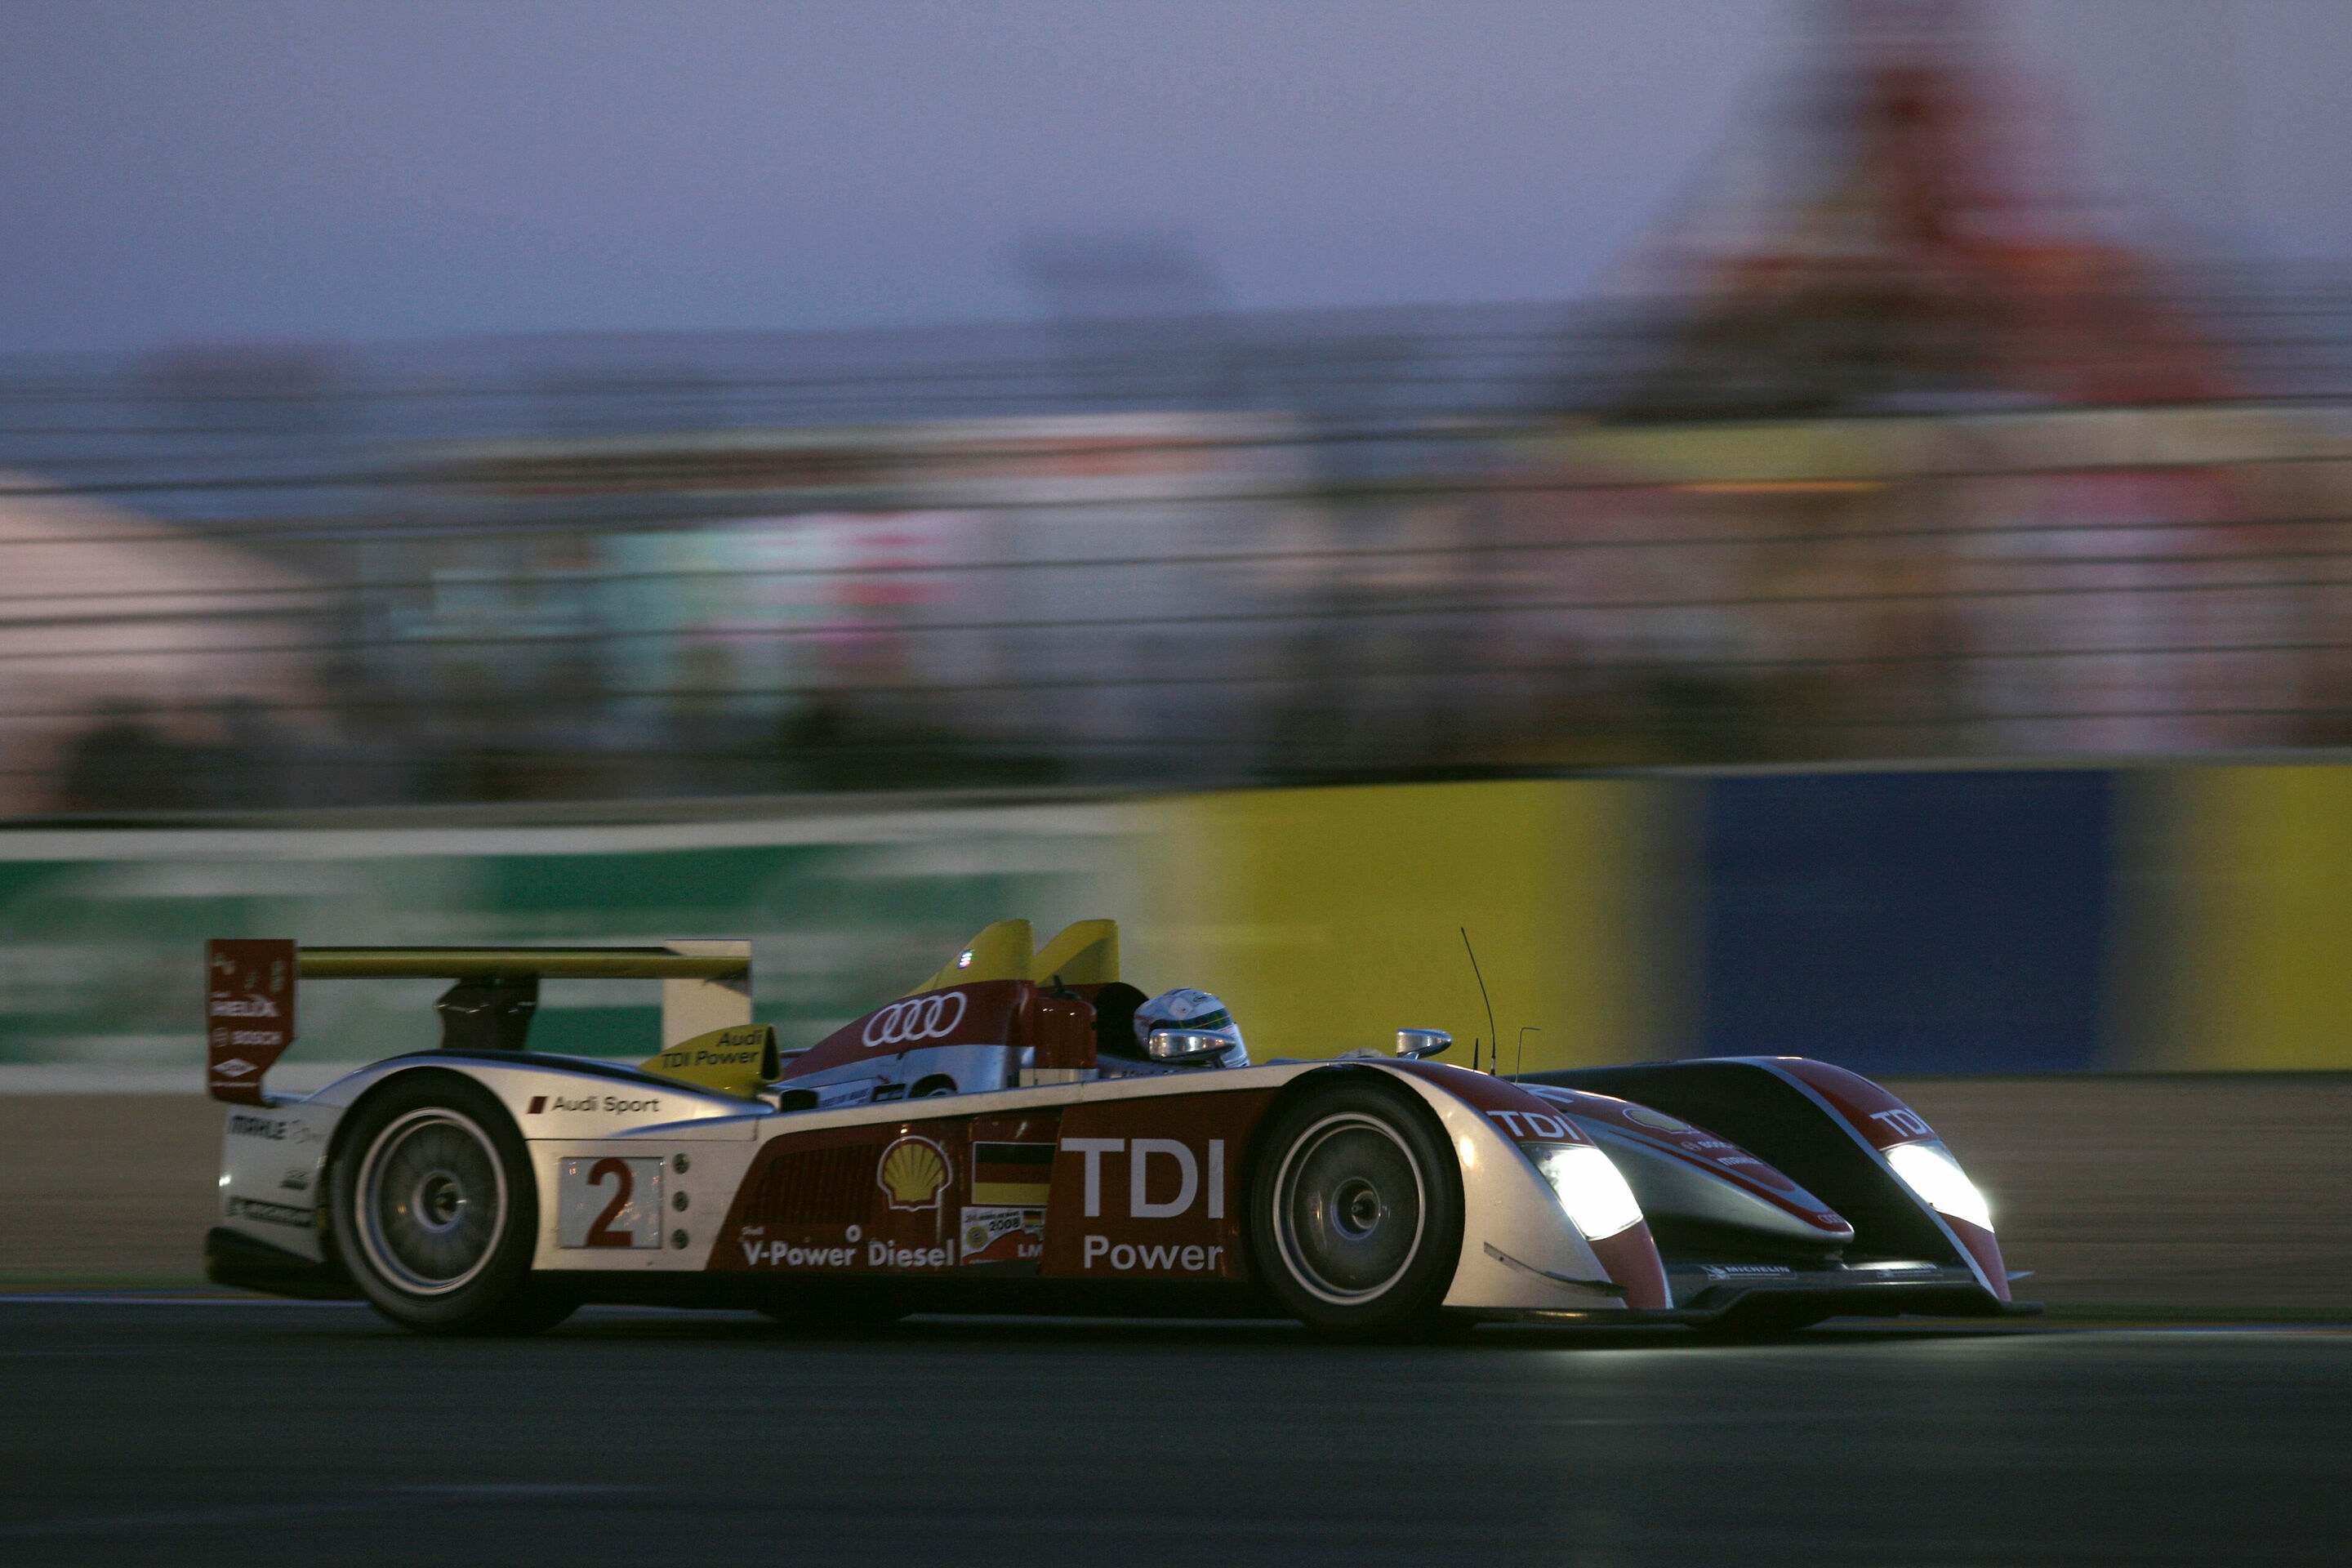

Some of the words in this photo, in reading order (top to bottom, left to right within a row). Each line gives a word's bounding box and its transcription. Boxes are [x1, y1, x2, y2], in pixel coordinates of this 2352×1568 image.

[716, 1030, 763, 1047] Audi
[661, 1052, 689, 1068] TDI
[694, 1049, 759, 1067] Power
[550, 1095, 597, 1112] Audi
[604, 1095, 660, 1116] Sport
[1486, 1110, 1581, 1141] TDI
[1869, 1108, 1936, 1138] TDI
[1059, 1137, 1225, 1219] TDI
[585, 1158, 633, 1247] 2
[988, 1217, 1021, 1232] 2008
[742, 1240, 858, 1267] V-Power
[867, 1238, 956, 1267] Diesel
[1083, 1234, 1224, 1272] Power
[1725, 1265, 1791, 1274] MICHELIN
